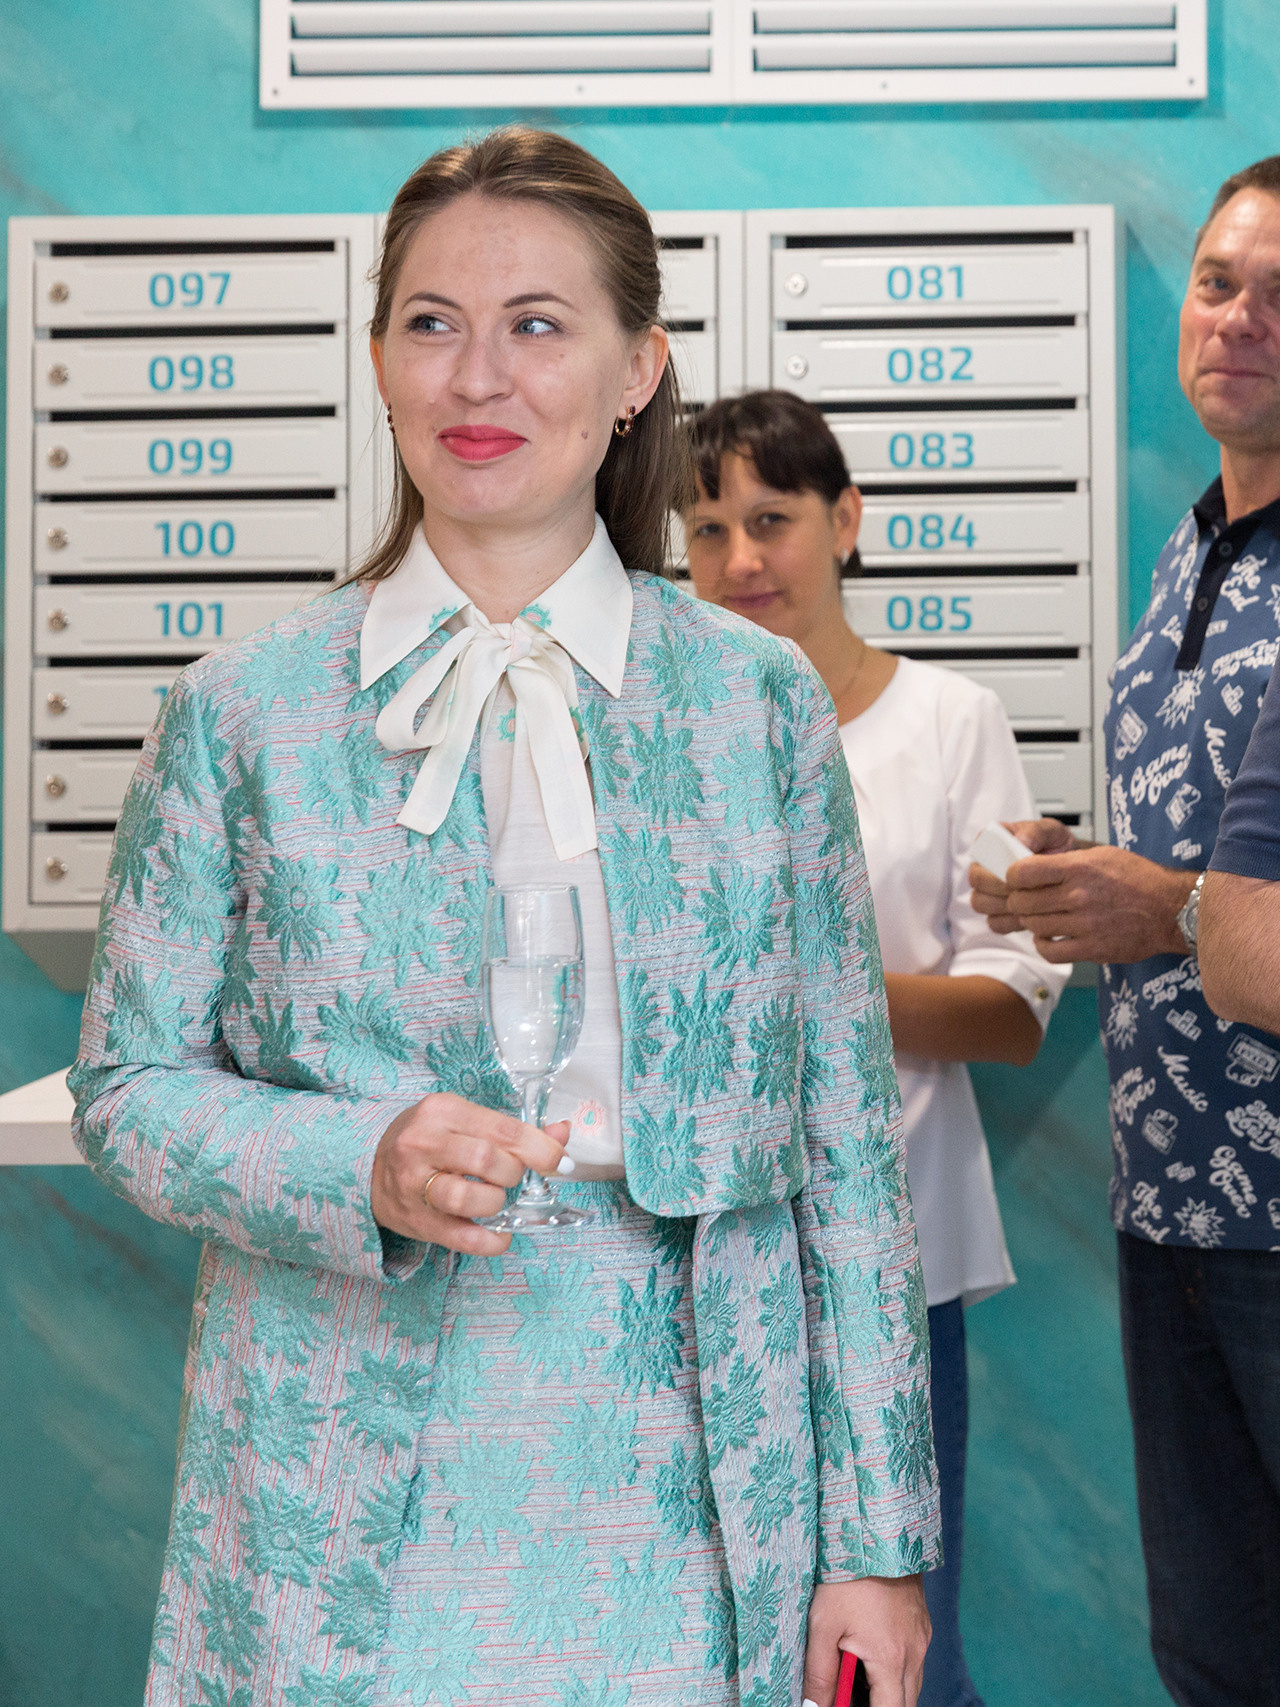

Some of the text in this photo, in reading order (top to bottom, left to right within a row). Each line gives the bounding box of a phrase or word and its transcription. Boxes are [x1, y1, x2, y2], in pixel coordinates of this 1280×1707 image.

[149, 272, 231, 308] 097
[887, 265, 963, 300] 081
[148, 355, 234, 392] 098
[887, 347, 974, 384] 082
[148, 439, 233, 475] 099
[888, 432, 975, 469] 083
[155, 521, 235, 557] 100
[887, 514, 977, 550] 084
[155, 602, 223, 638] 101
[886, 595, 972, 632] 085
[1130, 743, 1189, 806] Game
[1157, 1045, 1209, 1113] Music
[1208, 1168, 1252, 1218] Over
[1210, 1144, 1258, 1206] Game
